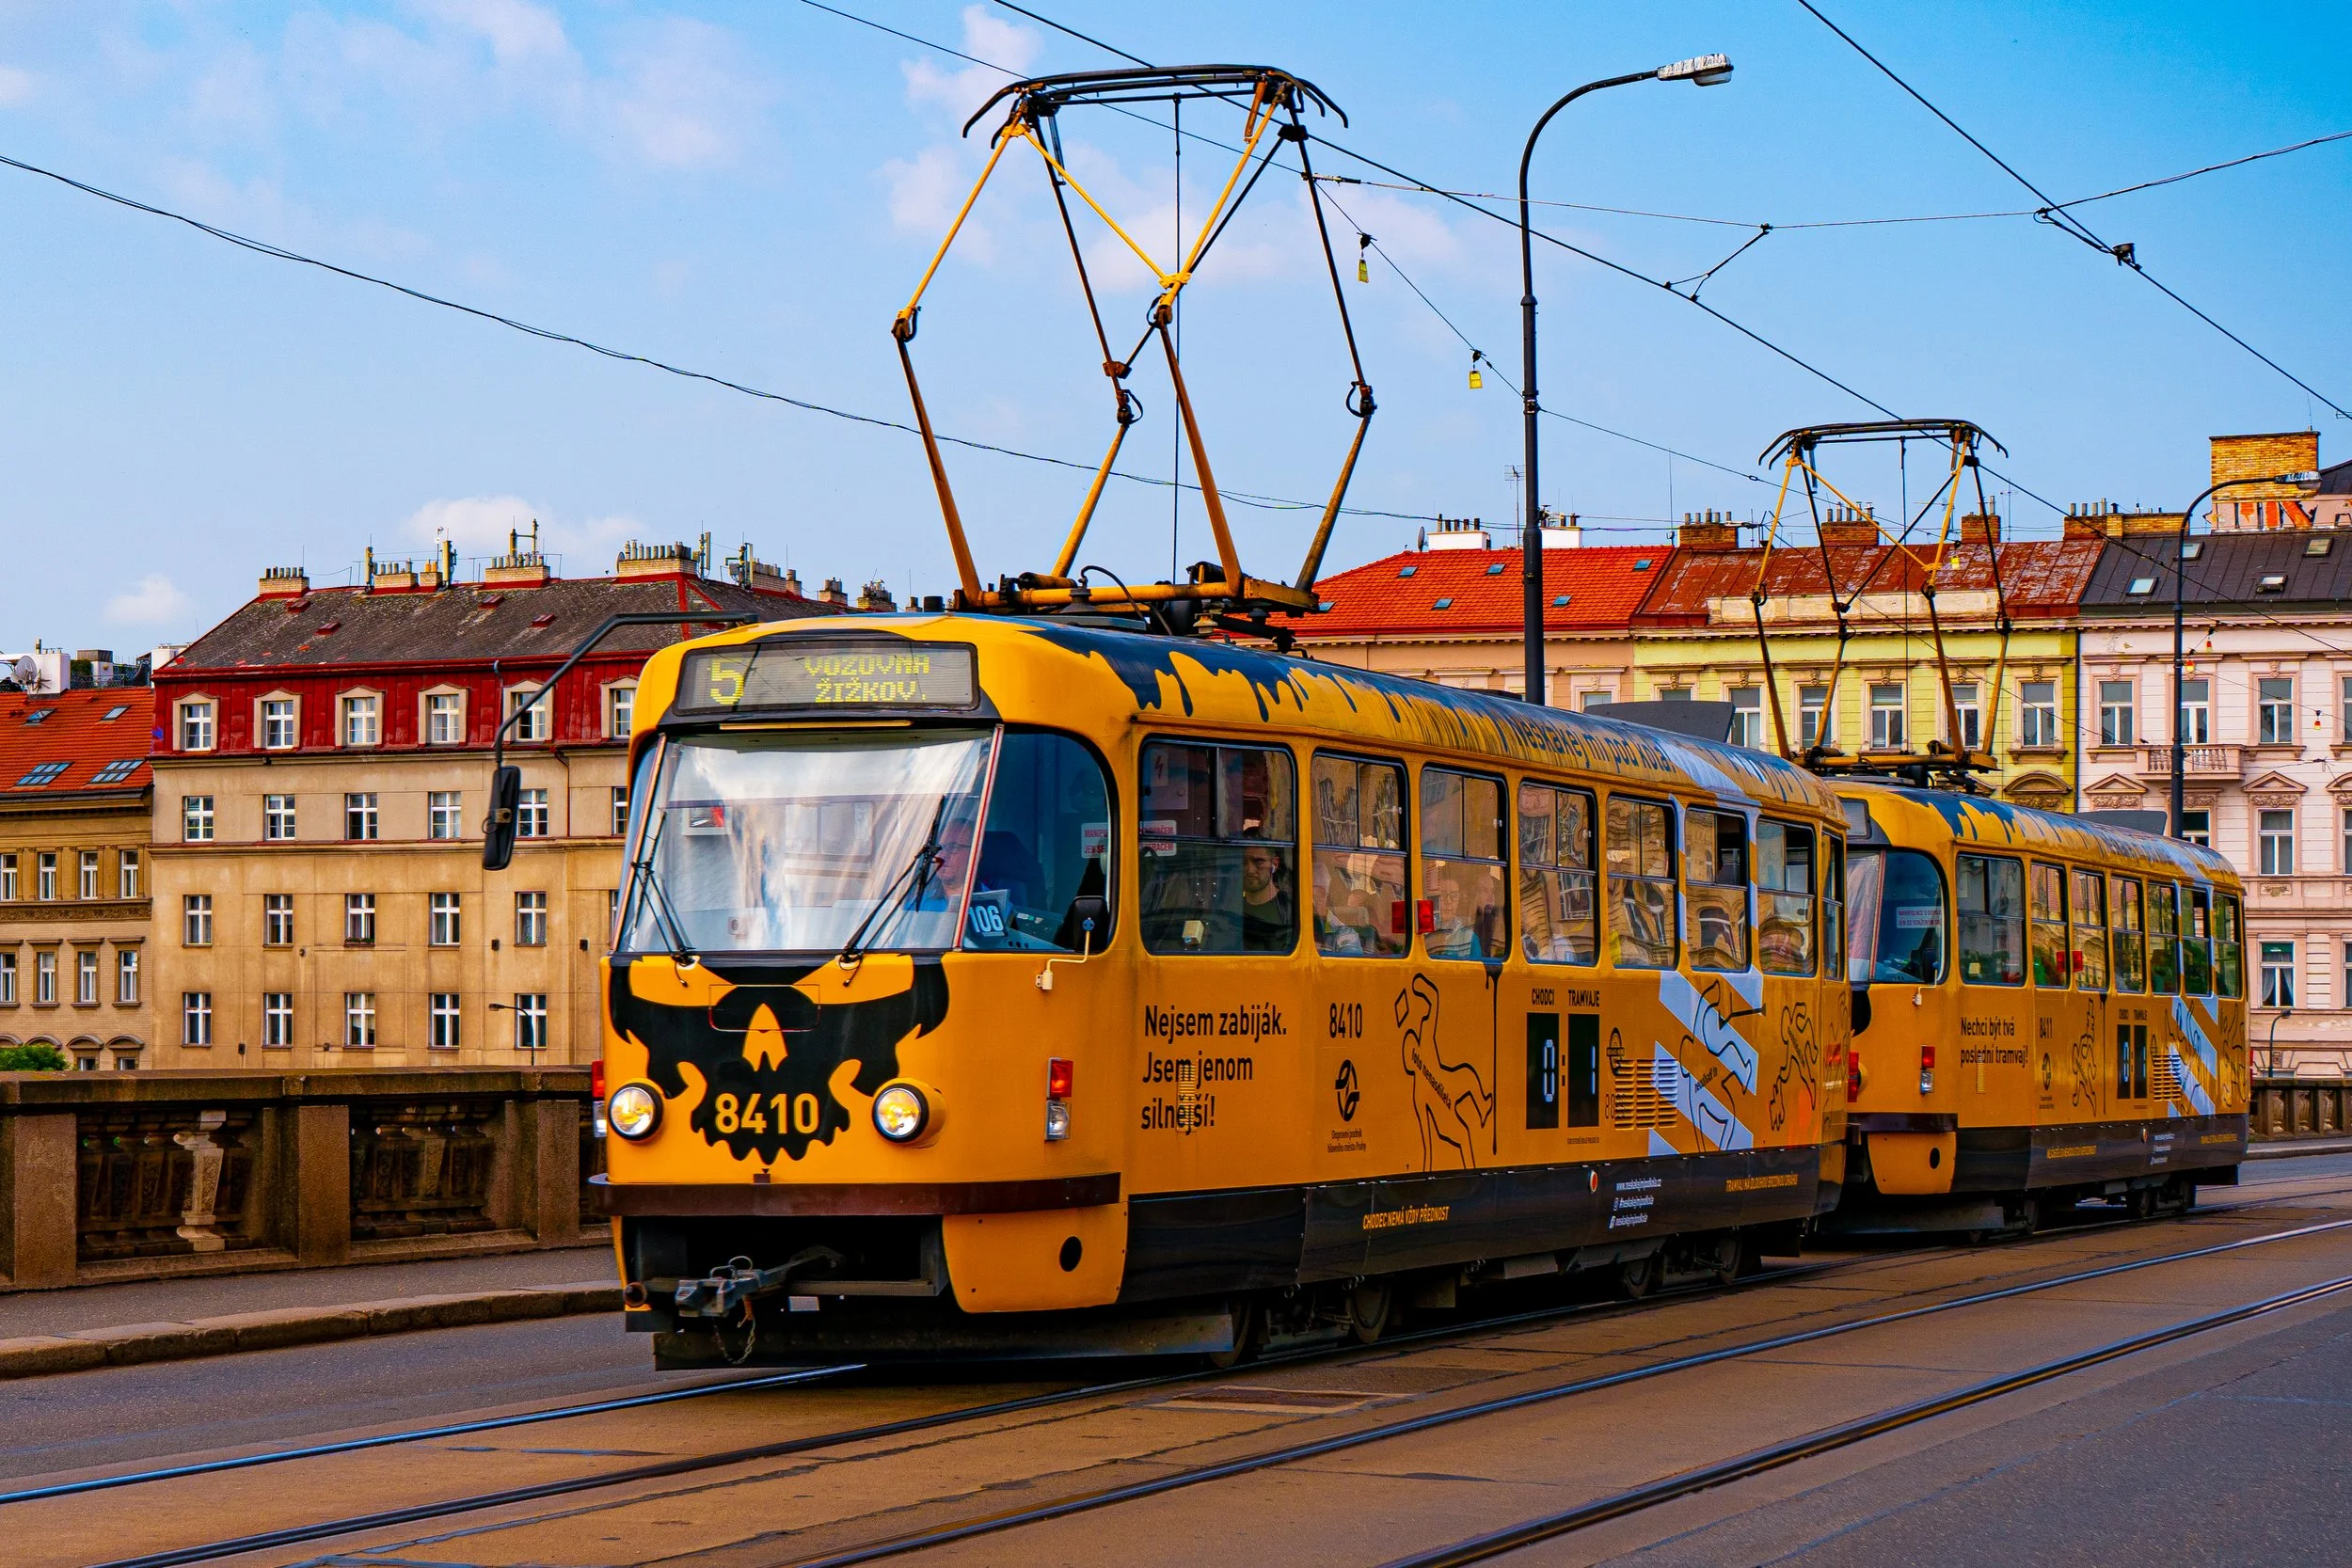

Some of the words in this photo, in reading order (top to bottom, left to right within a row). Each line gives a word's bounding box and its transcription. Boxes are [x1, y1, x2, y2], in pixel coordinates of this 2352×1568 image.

[707, 659, 745, 705] 5
[804, 653, 930, 675] VOZOVNA
[1585, 733, 1611, 761] mi
[1603, 735, 1640, 773] pod
[968, 904, 1005, 934] 106
[1532, 988, 1554, 1006] CHODCI
[1568, 990, 1599, 1007] TRAMVAJE
[1145, 1005, 1214, 1044] Nejsem
[1219, 1002, 1287, 1043] zabiják.
[1329, 1002, 1363, 1038] 8410
[1961, 1017, 1988, 1037] Nechci
[1989, 1016, 2001, 1041] být
[2003, 1016, 2015, 1037] tvá
[2040, 1017, 2053, 1039] 8411
[1143, 1052, 1192, 1083] Jsem
[1196, 1051, 1253, 1089] jenom
[1543, 1039, 1555, 1102] 0
[1591, 1045, 1597, 1096] 1
[1961, 1044, 1994, 1069] poslední
[1995, 1045, 2028, 1069] tramvaj!
[715, 1092, 819, 1134] 8410
[1141, 1093, 1216, 1135] silnější!
[1363, 1212, 1388, 1229] CHODEC
[1387, 1206, 1405, 1227] NEMÁ
[1406, 1205, 1420, 1225] VŽDY
[1420, 1204, 1450, 1223] PŘEDNOST
